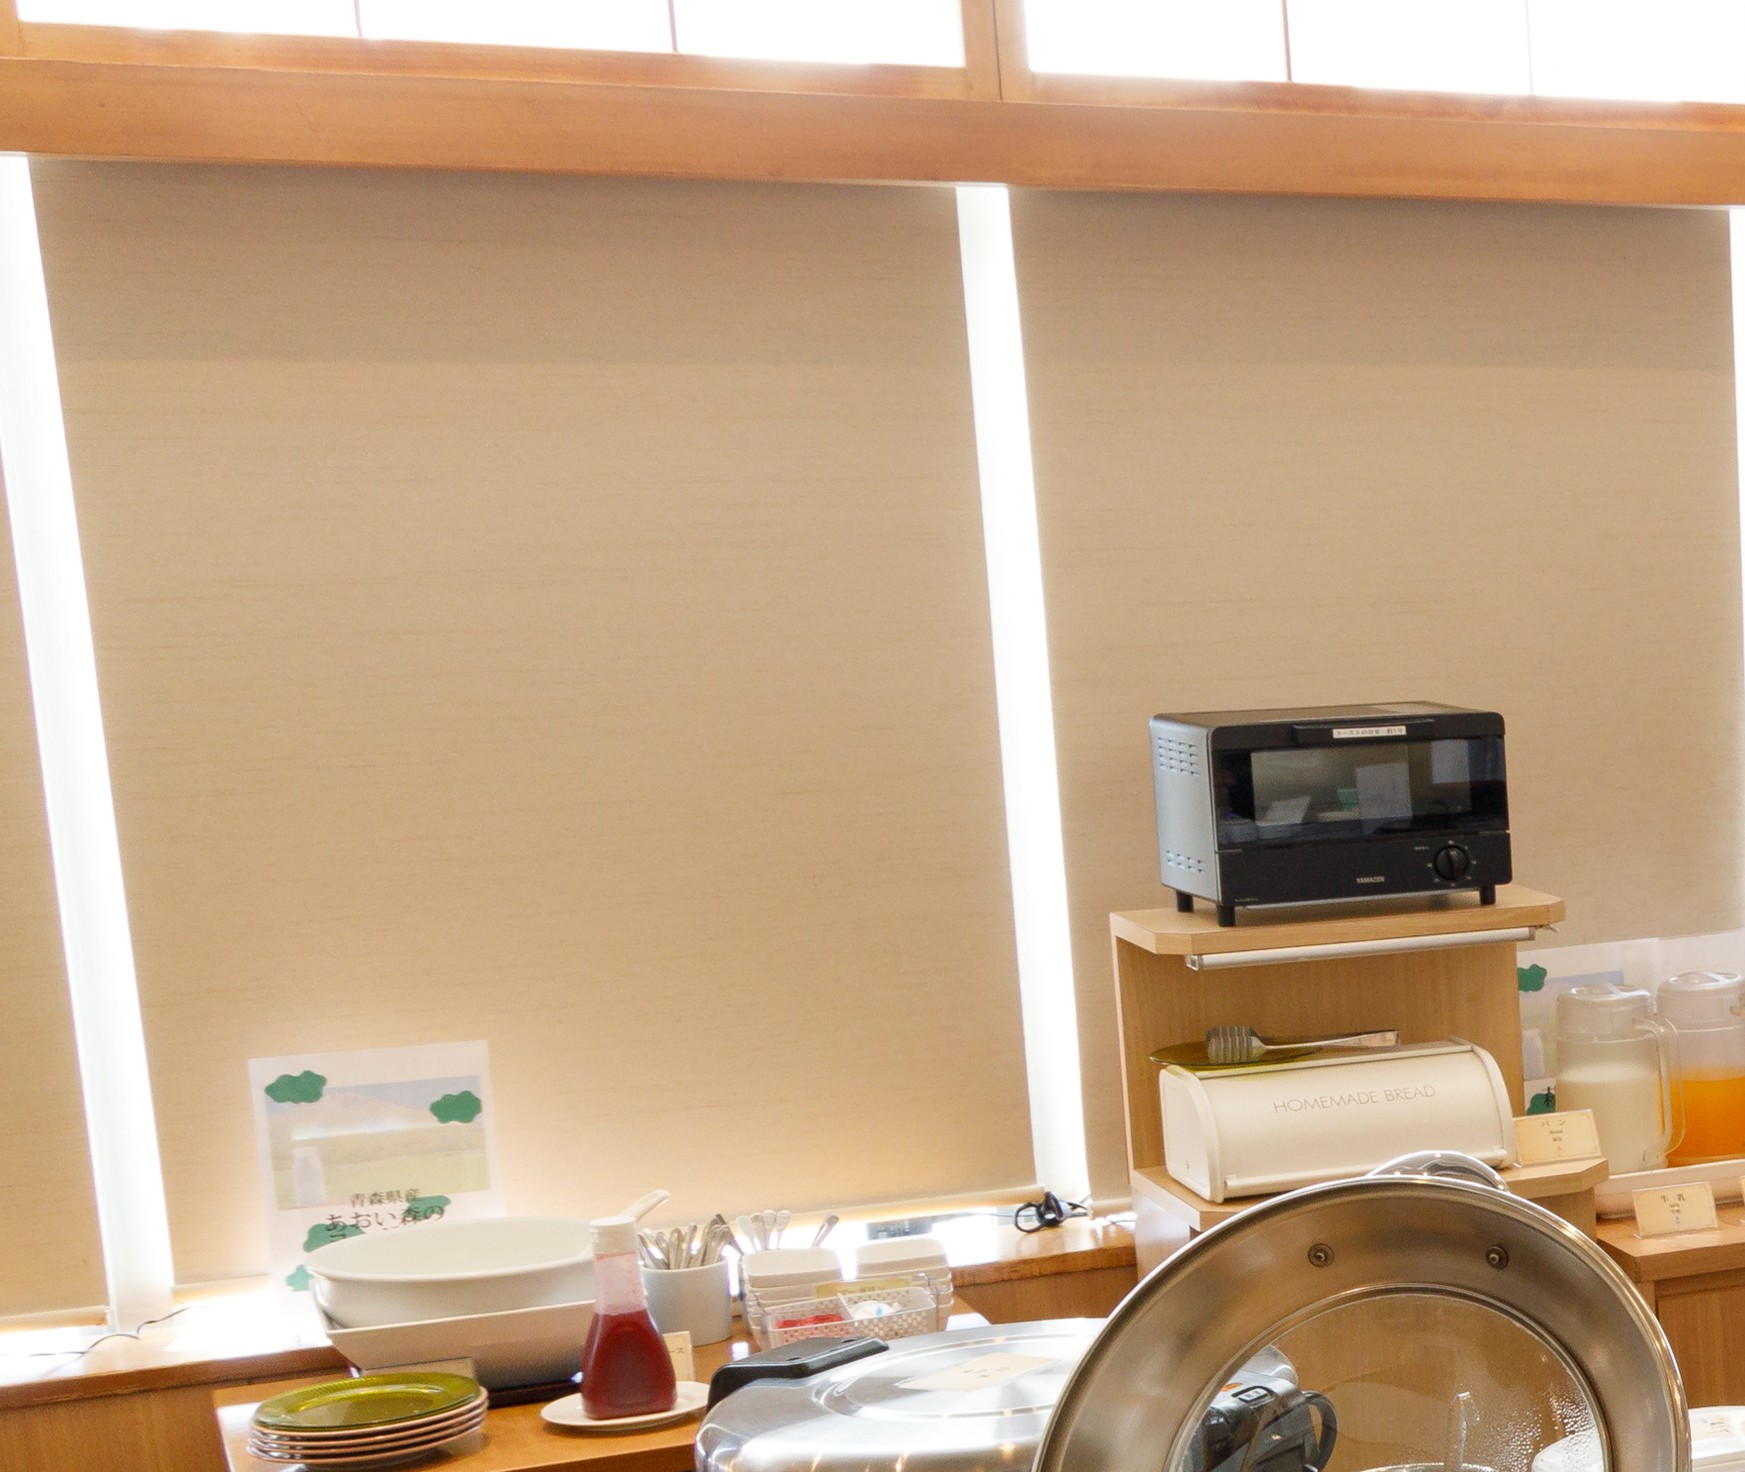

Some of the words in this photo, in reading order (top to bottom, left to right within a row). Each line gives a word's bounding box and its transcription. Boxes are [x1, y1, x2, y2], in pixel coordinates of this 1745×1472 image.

[1273, 1091, 1378, 1114] HOMEMADE
[1385, 1084, 1437, 1105] BREAD
[350, 1188, 421, 1208] 青森県産
[325, 1203, 446, 1233] あおい森の
